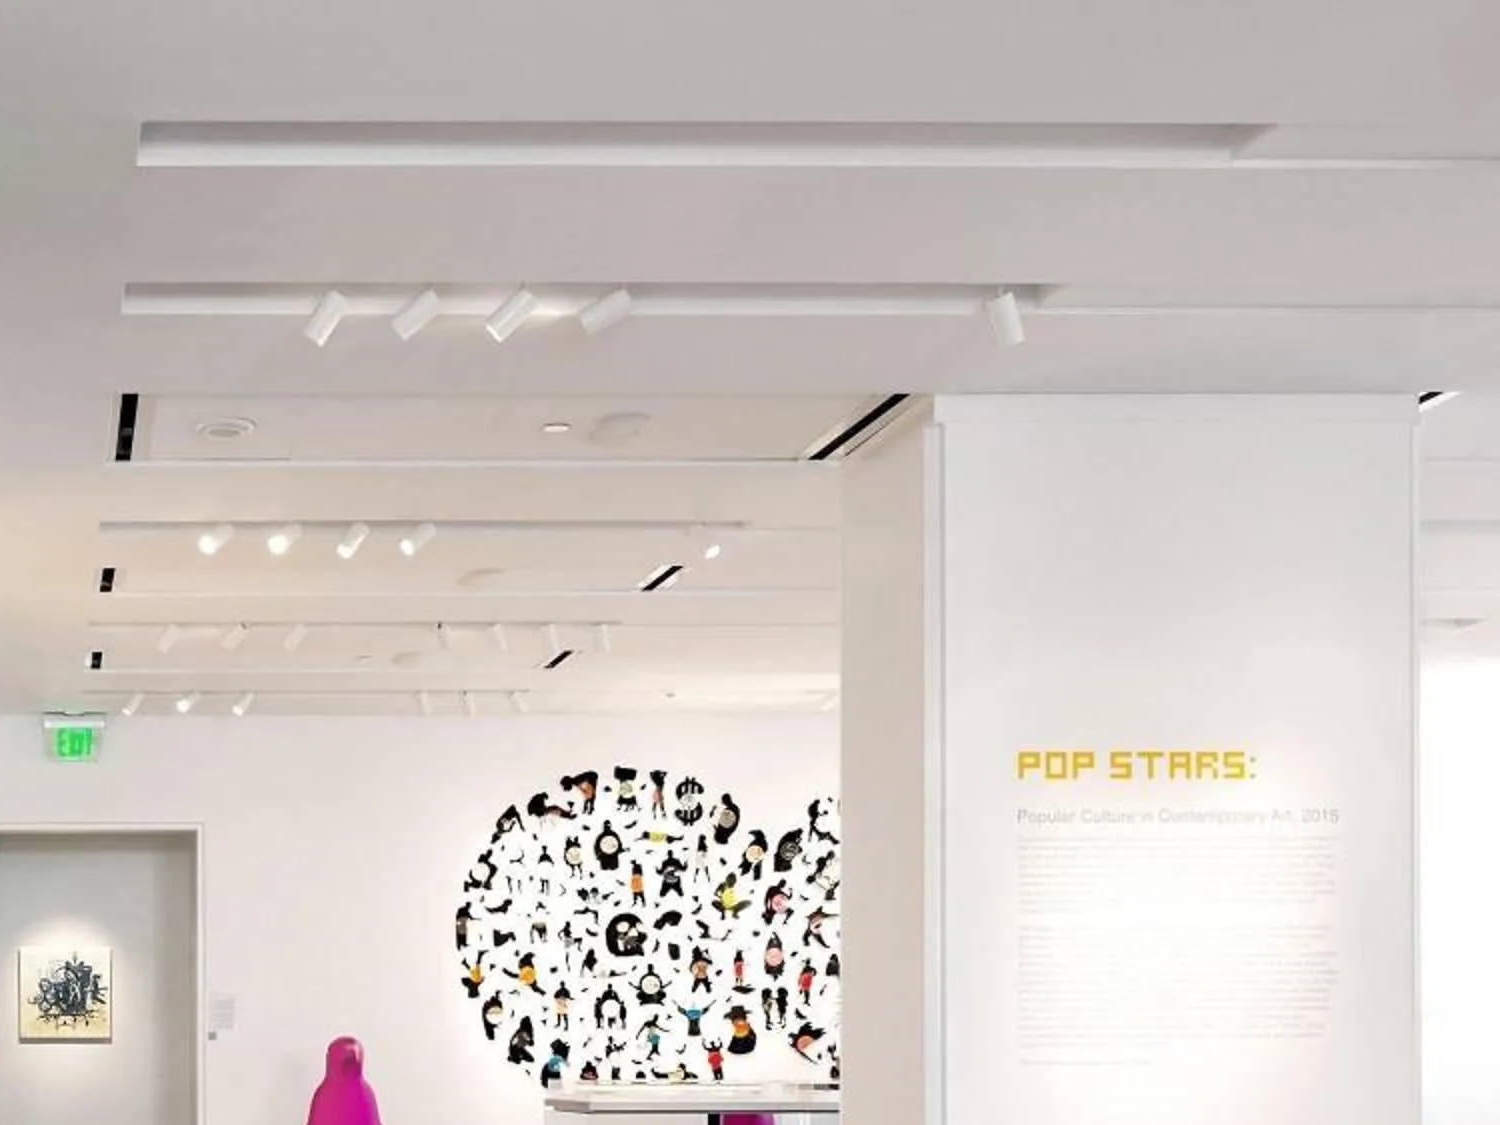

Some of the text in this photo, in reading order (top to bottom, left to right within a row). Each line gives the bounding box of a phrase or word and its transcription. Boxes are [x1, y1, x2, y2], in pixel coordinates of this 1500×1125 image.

[1017, 751, 1257, 779] POP STARS:
[1016, 808, 1076, 828] Popular
[1080, 808, 1137, 825] Culture
[1301, 807, 1340, 824] 2015
